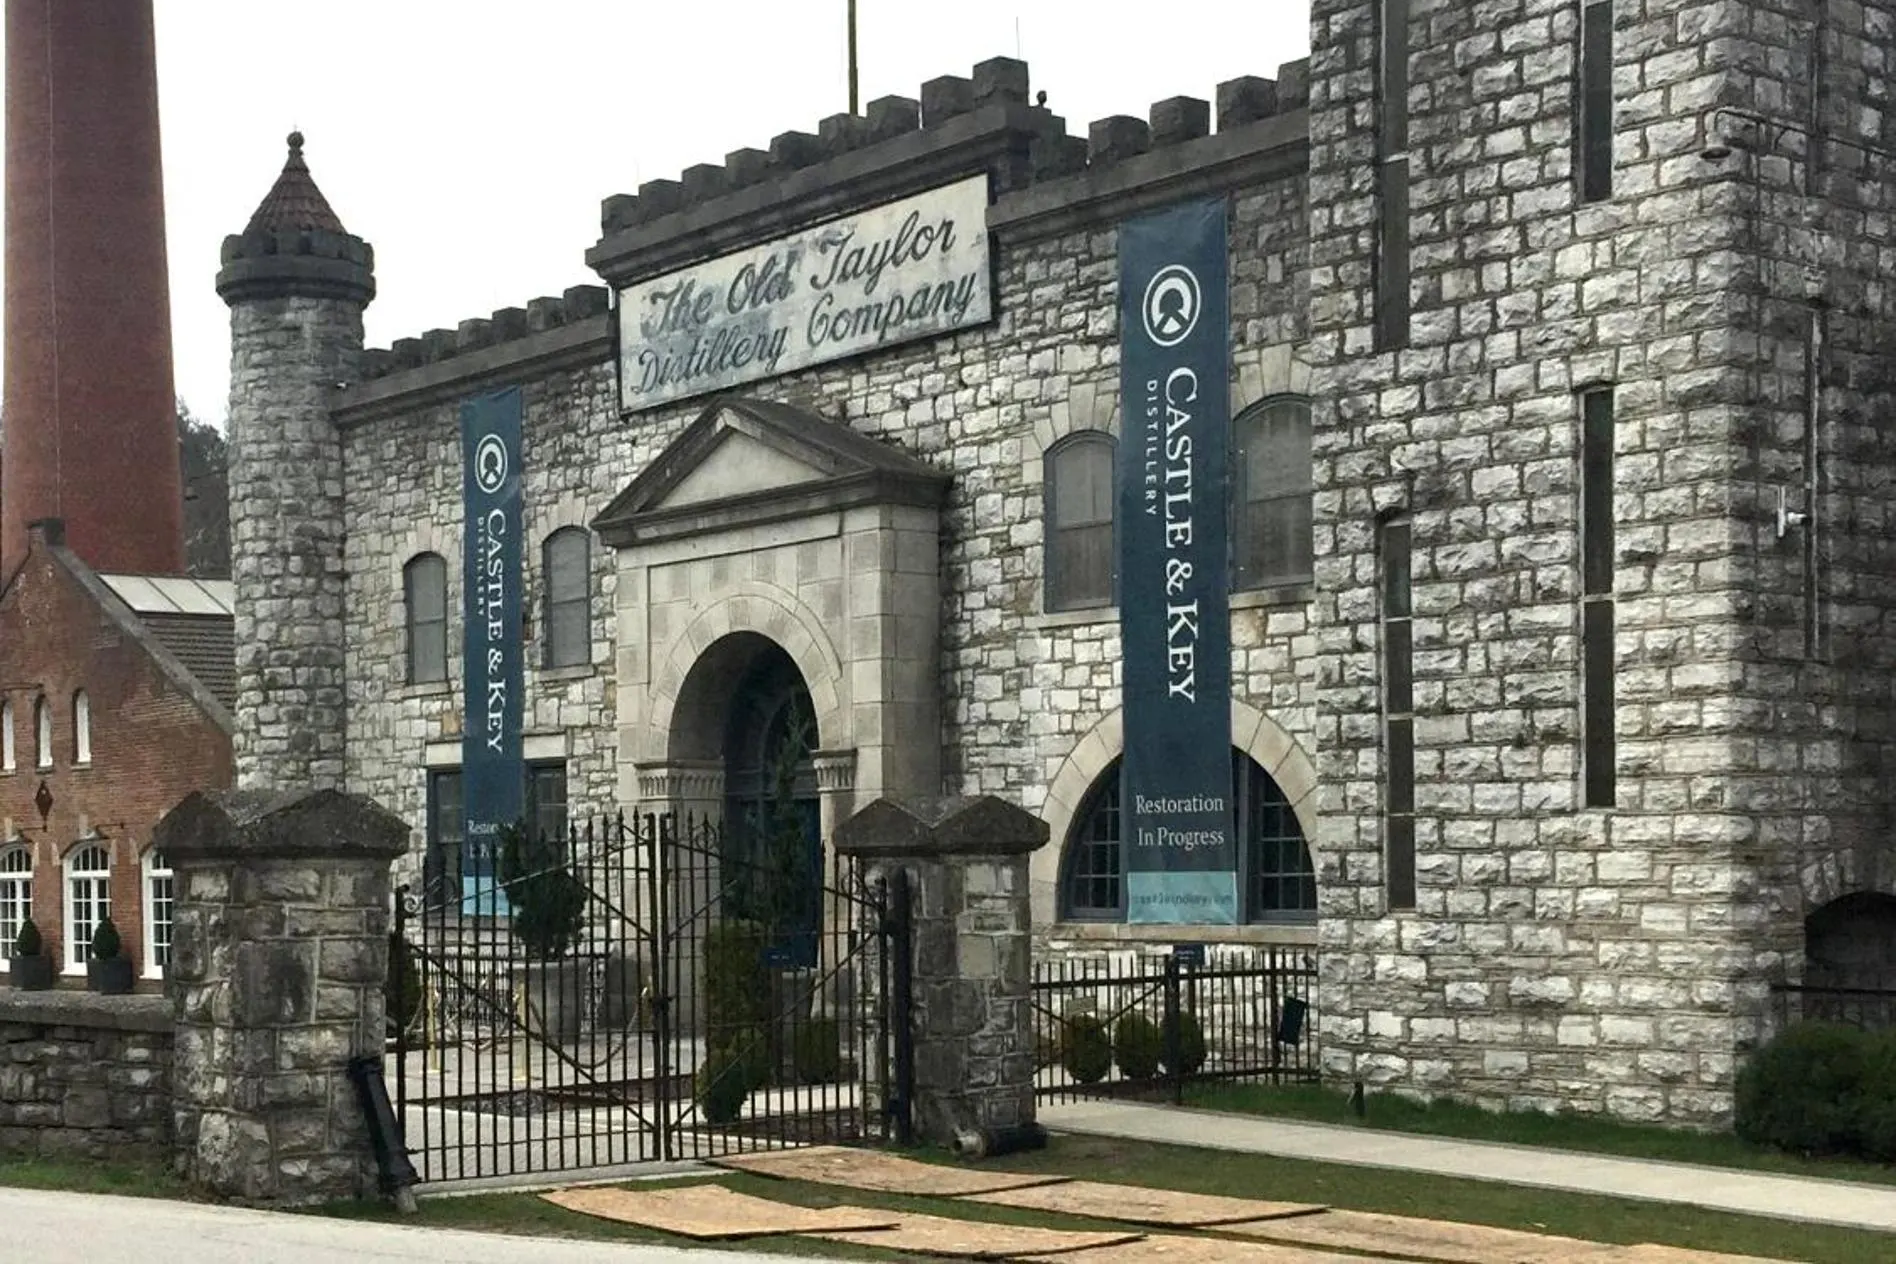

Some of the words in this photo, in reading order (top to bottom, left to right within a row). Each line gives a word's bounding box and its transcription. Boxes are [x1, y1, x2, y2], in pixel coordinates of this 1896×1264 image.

[642, 277, 715, 337] The
[727, 250, 797, 314] Old
[810, 210, 957, 296] Taylor
[631, 325, 788, 394] Distillery
[807, 272, 976, 347] Company
[1145, 379, 1159, 515] DISTILLERY
[1165, 366, 1198, 549] CASTLE
[477, 516, 485, 616] DISTILLERY
[488, 508, 506, 641] CASTLE
[1165, 558, 1193, 596] &
[488, 648, 503, 675] &
[1167, 598, 1199, 704] KEY
[487, 678, 506, 754] KEY
[1136, 793, 1224, 814] Restoration
[1138, 828, 1154, 847] In
[1157, 827, 1225, 852] Progress
